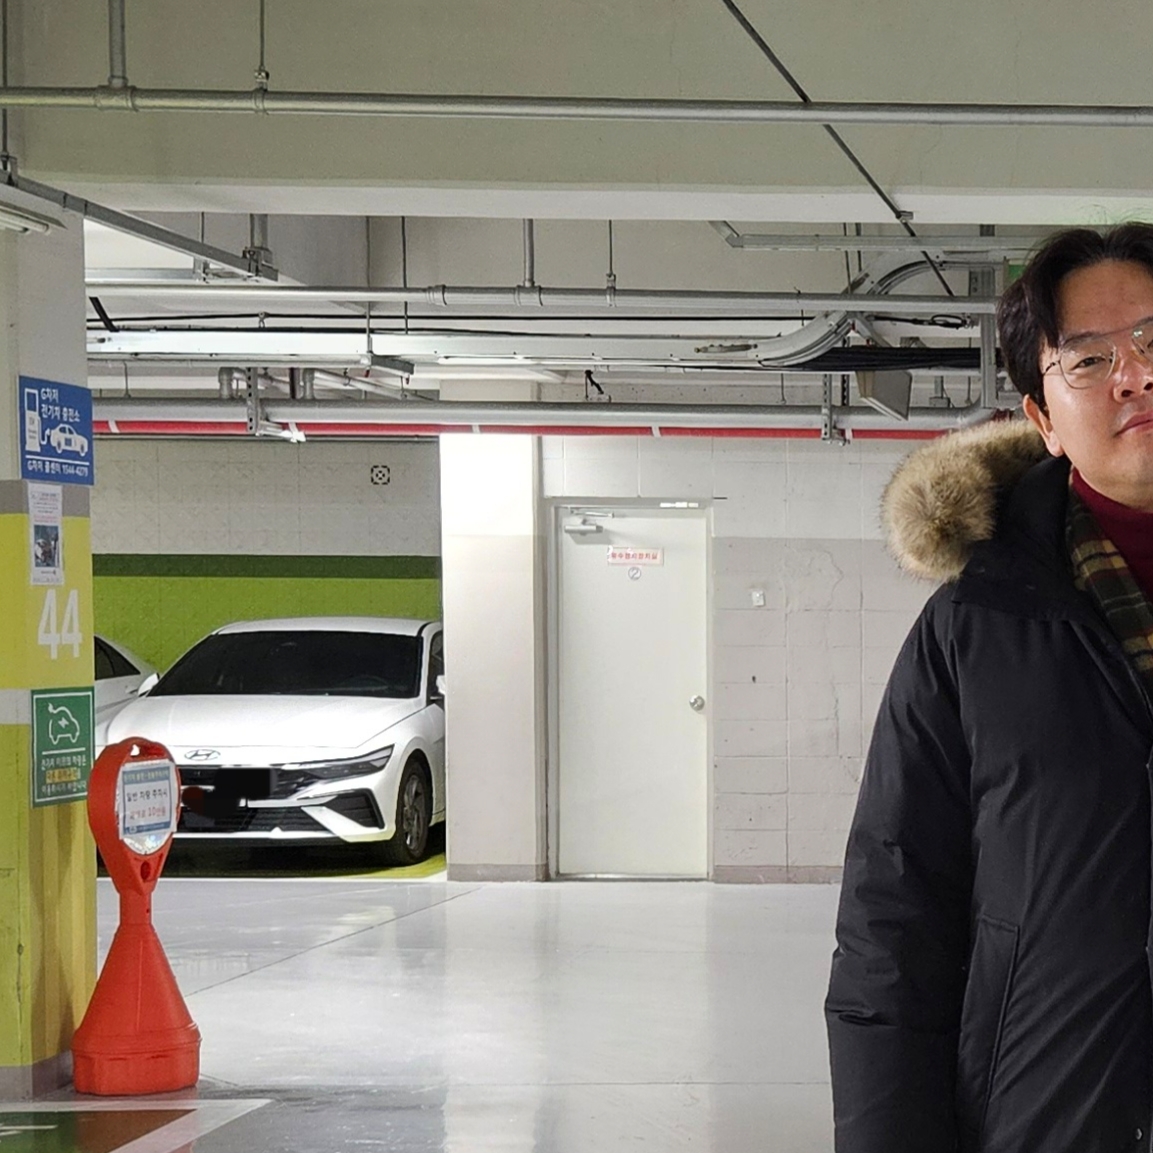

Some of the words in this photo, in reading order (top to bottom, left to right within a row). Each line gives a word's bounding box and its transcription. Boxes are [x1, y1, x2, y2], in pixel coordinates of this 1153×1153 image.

[41, 404, 60, 419] 전기차
[62, 407, 81, 422] 충전소
[38, 588, 82, 659] 44
[127, 792, 138, 802] 일반
[140, 790, 151, 800] 차량
[152, 788, 168, 798] 주차시
